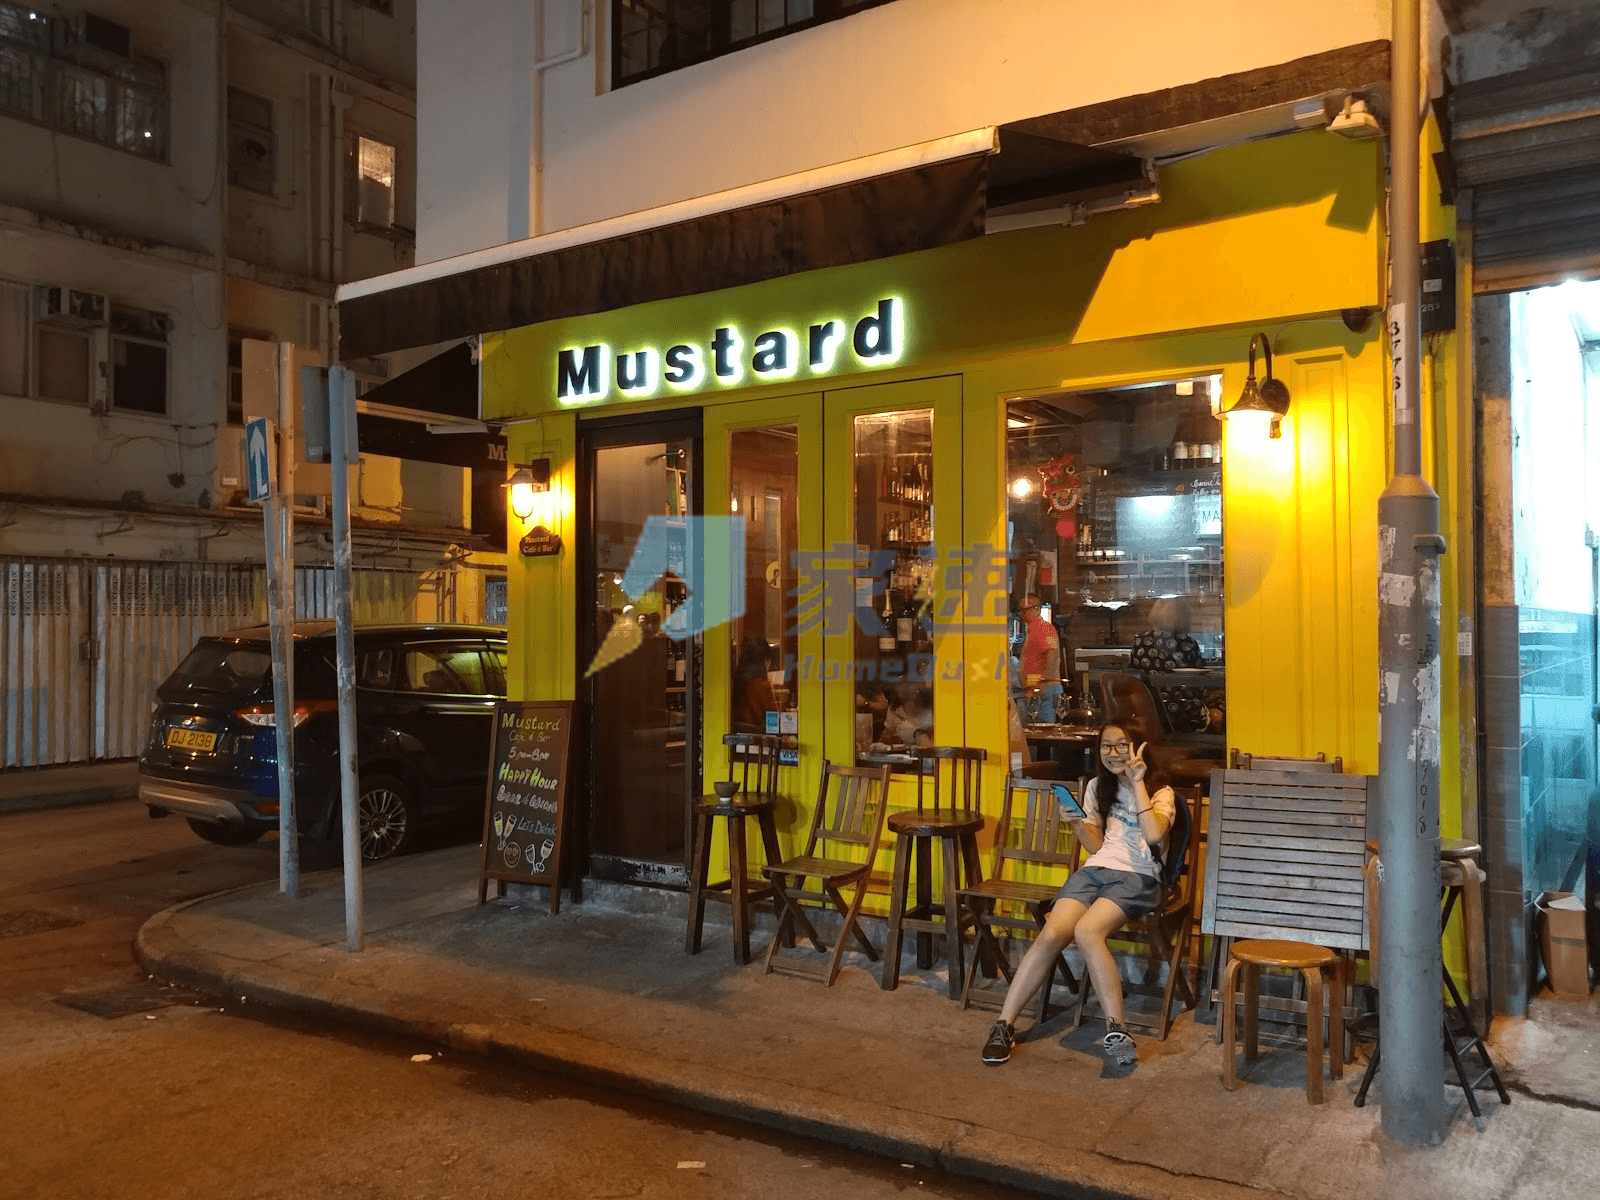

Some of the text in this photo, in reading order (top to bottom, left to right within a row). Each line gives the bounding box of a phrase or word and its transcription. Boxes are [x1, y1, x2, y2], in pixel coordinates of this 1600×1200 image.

[556, 297, 898, 400] Mustard
[487, 443, 508, 461] M
[525, 535, 550, 544] Mustard
[501, 712, 562, 732] Mustard
[171, 730, 214, 748] DJ 2138
[536, 731, 552, 743] Bar
